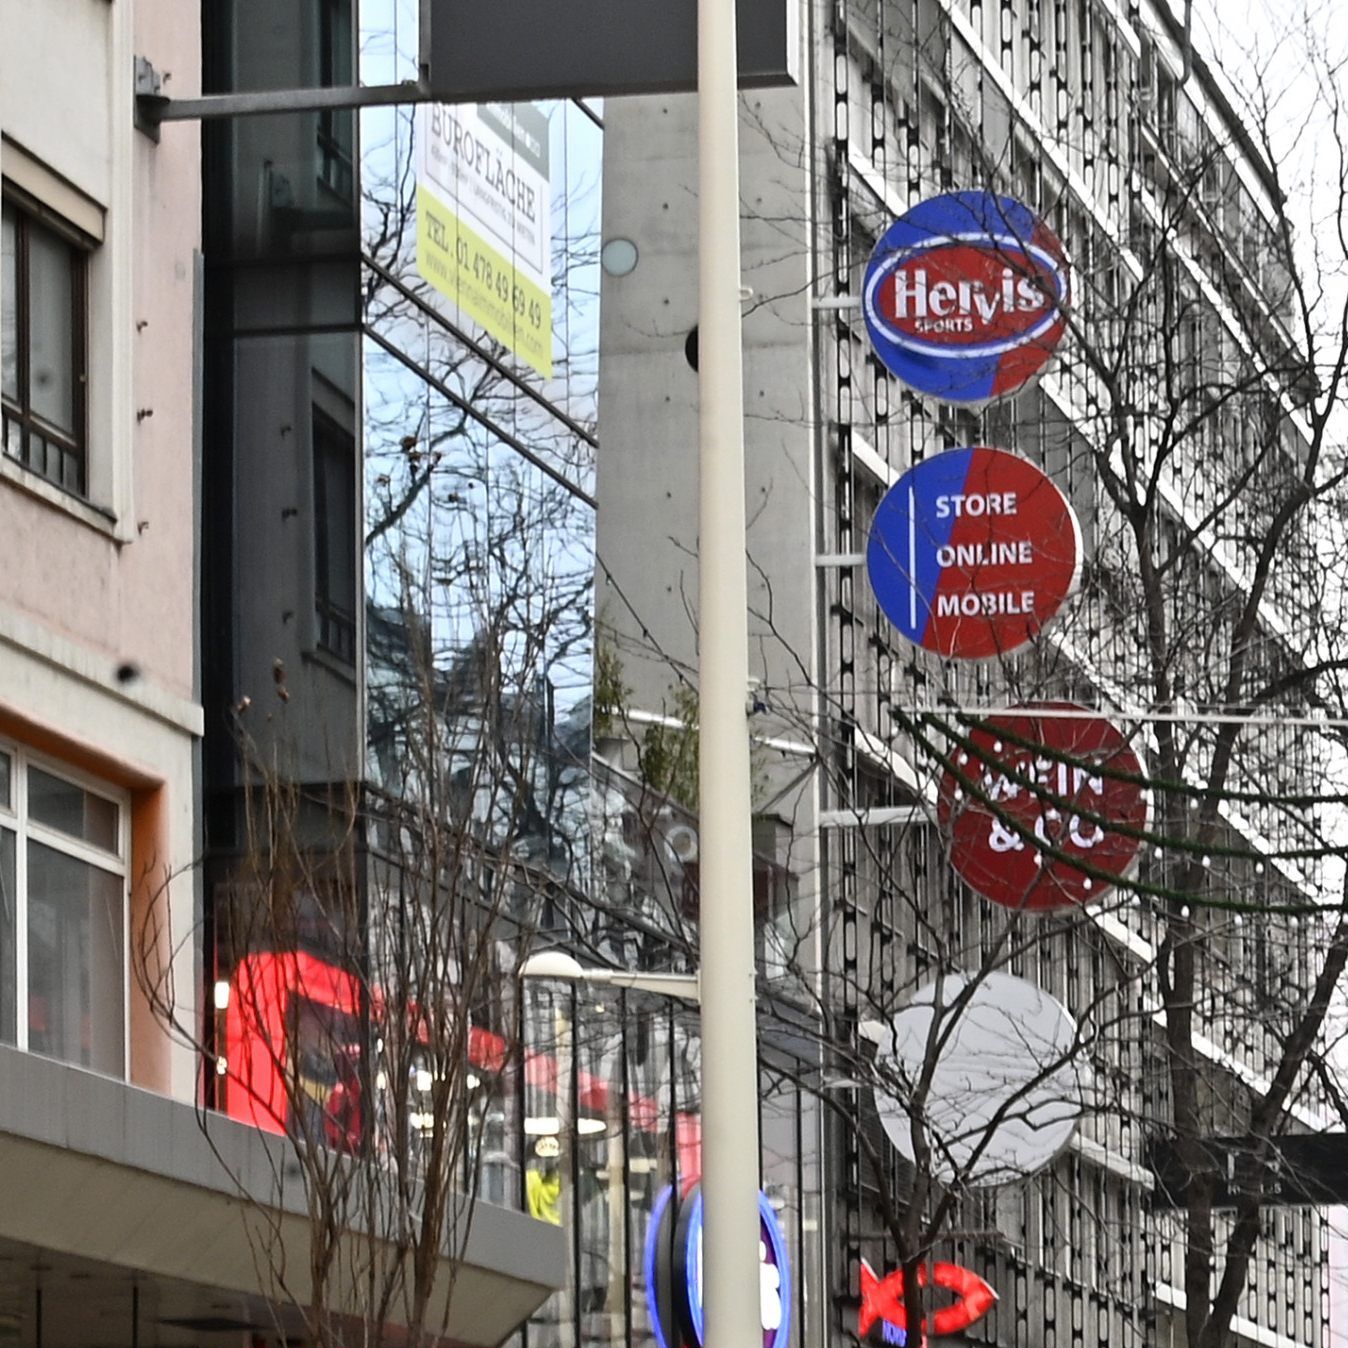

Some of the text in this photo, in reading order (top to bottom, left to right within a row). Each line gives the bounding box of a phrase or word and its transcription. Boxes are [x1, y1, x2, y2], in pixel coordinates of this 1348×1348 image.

[473, 251, 494, 291] 478
[495, 271, 509, 303] 49
[528, 298, 542, 330] 49
[895, 268, 1044, 325] Hervis
[914, 317, 973, 334] SPORTS
[936, 492, 1018, 519] STORE
[936, 541, 1033, 568] ONLINE
[938, 591, 1035, 618] MOBILE
